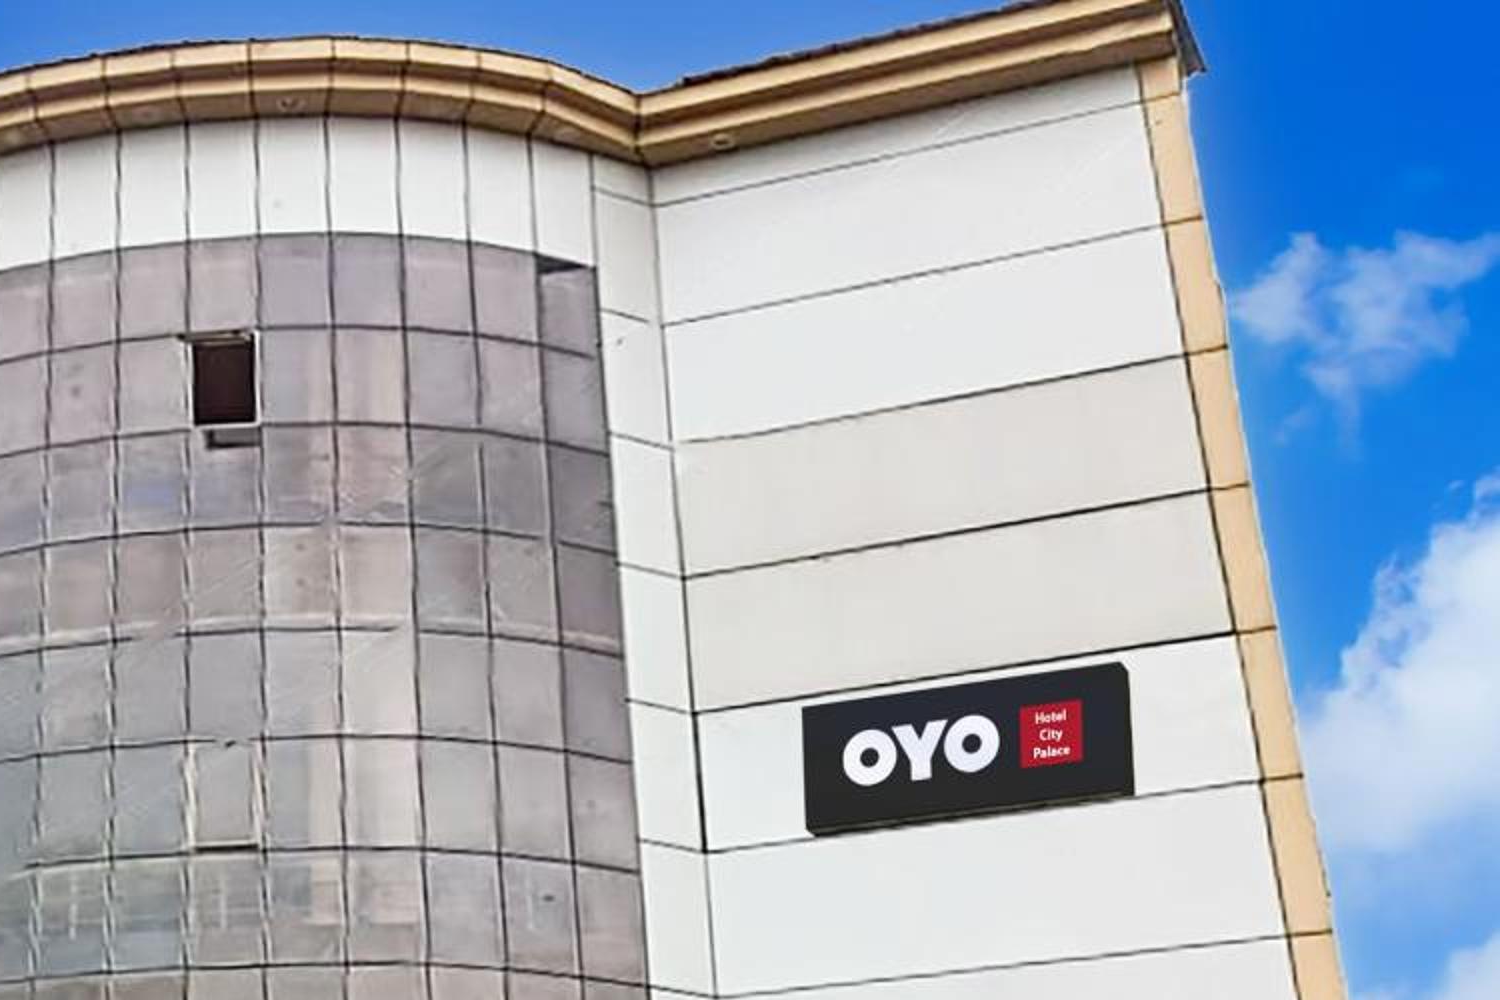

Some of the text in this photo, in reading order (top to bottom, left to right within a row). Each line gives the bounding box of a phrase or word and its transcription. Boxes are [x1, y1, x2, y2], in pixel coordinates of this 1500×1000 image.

[1034, 709, 1068, 725] Hotel
[1039, 727, 1064, 743] City
[842, 714, 1001, 788] OYO
[1032, 744, 1071, 760] Palace
